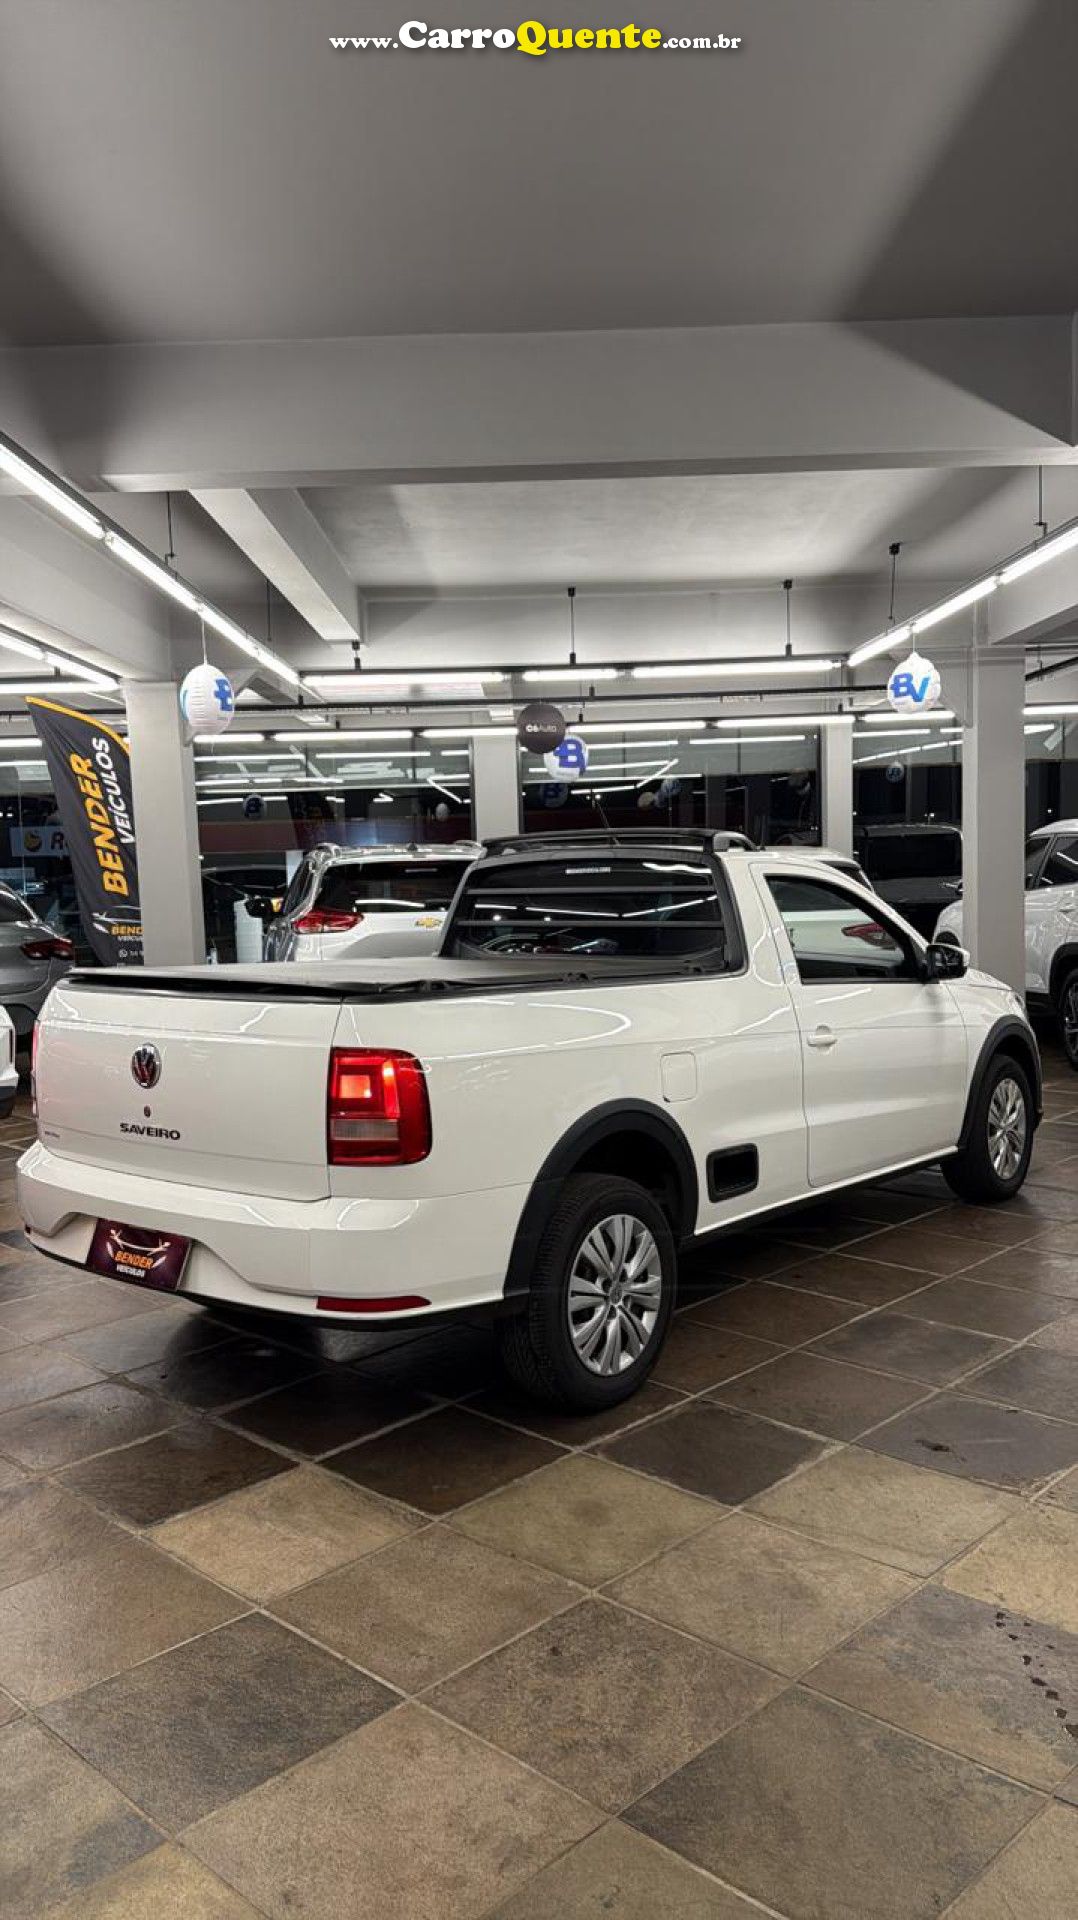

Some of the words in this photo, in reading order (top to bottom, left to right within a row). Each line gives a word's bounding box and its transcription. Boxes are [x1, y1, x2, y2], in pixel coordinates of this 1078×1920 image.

[889, 672, 931, 703] BV
[69, 752, 129, 897] BENDER
[92, 737, 136, 844] VEÍCULOS
[120, 1122, 181, 1141] SAVEIRO
